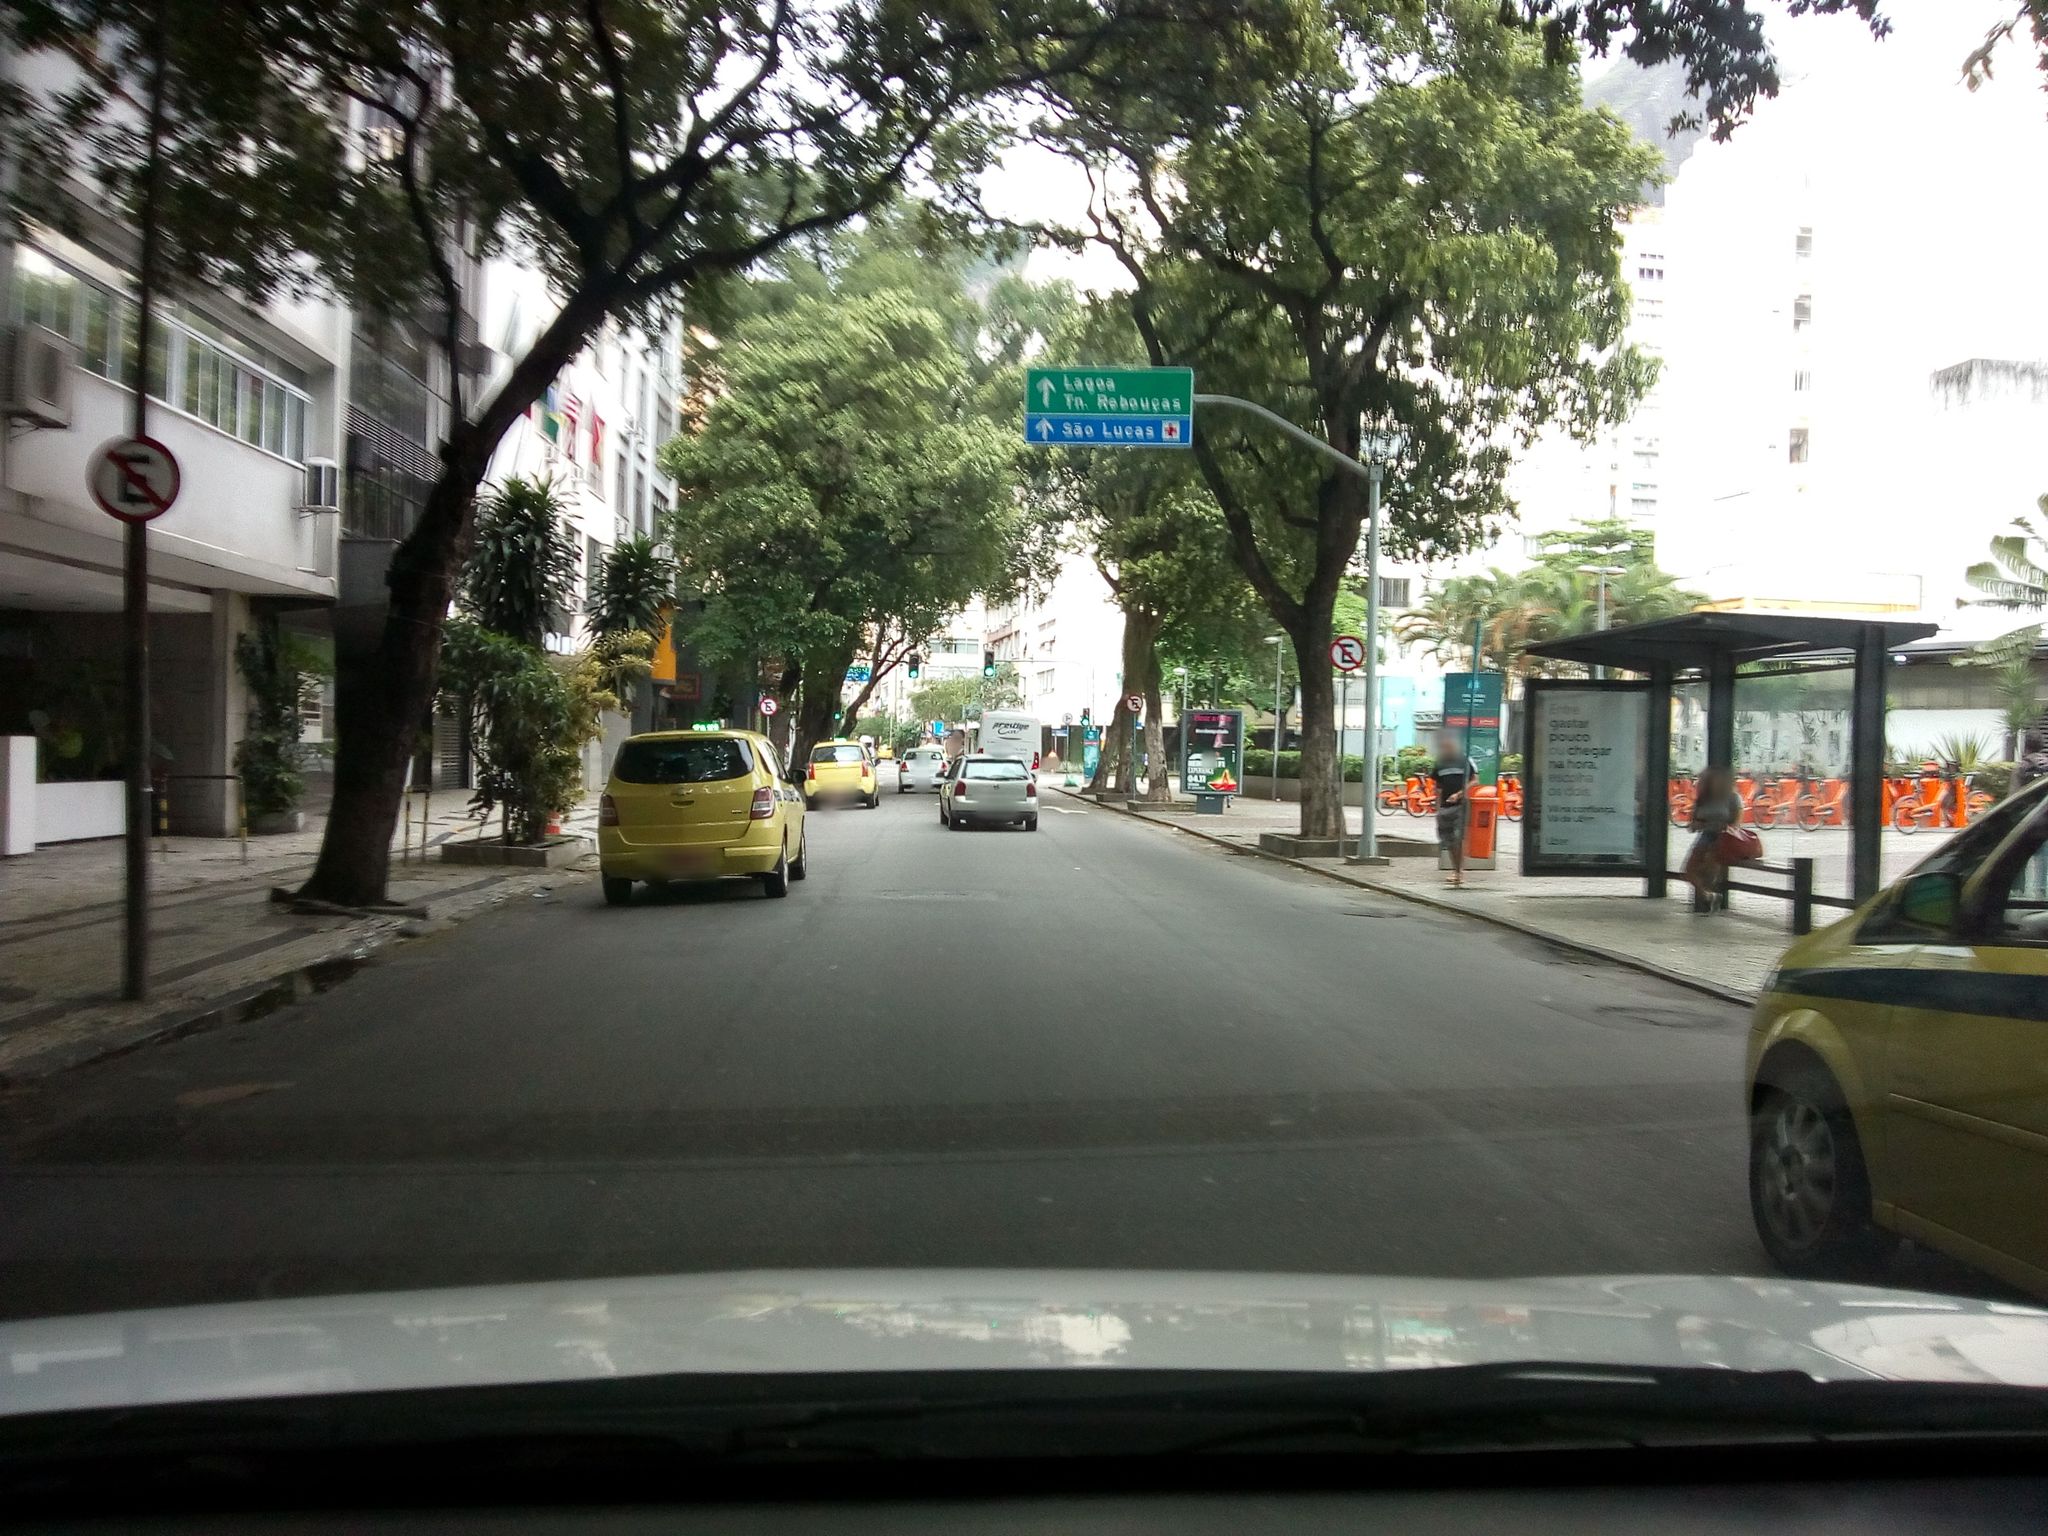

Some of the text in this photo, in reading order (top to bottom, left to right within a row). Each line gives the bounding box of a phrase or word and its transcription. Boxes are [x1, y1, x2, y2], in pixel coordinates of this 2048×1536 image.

[1063, 375, 1116, 394] Lagoa
[1097, 393, 1182, 412] Rebouças
[1062, 421, 1155, 439] São Lucas
[1549, 733, 1591, 744] pouco
[1567, 746, 1612, 759] chegar
